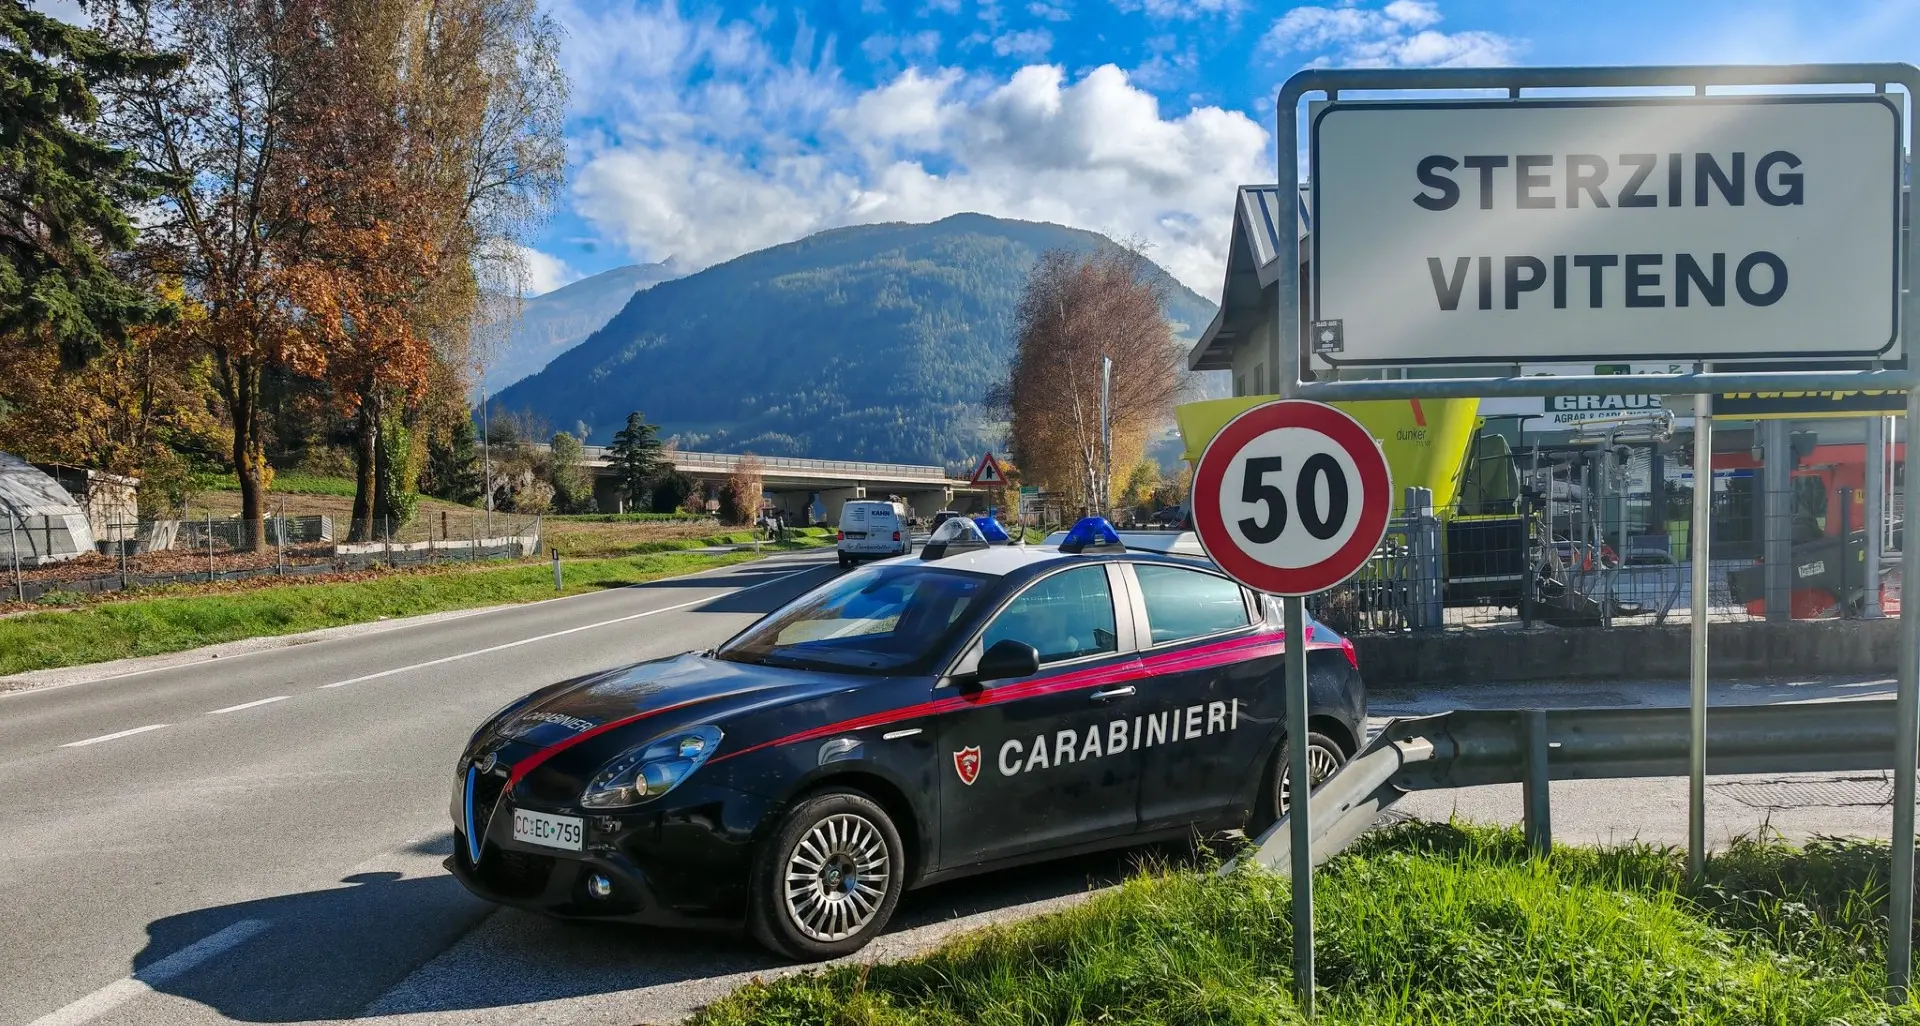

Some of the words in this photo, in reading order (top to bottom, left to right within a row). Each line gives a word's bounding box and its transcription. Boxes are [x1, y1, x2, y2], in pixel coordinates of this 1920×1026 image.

[1412, 150, 1804, 211] STERZING
[1426, 251, 1788, 311] VIPITENO
[1237, 453, 1348, 544] 50
[522, 711, 598, 733] CARABINIERI
[998, 698, 1238, 777] CARABINIERI
[557, 823, 581, 844] 759
